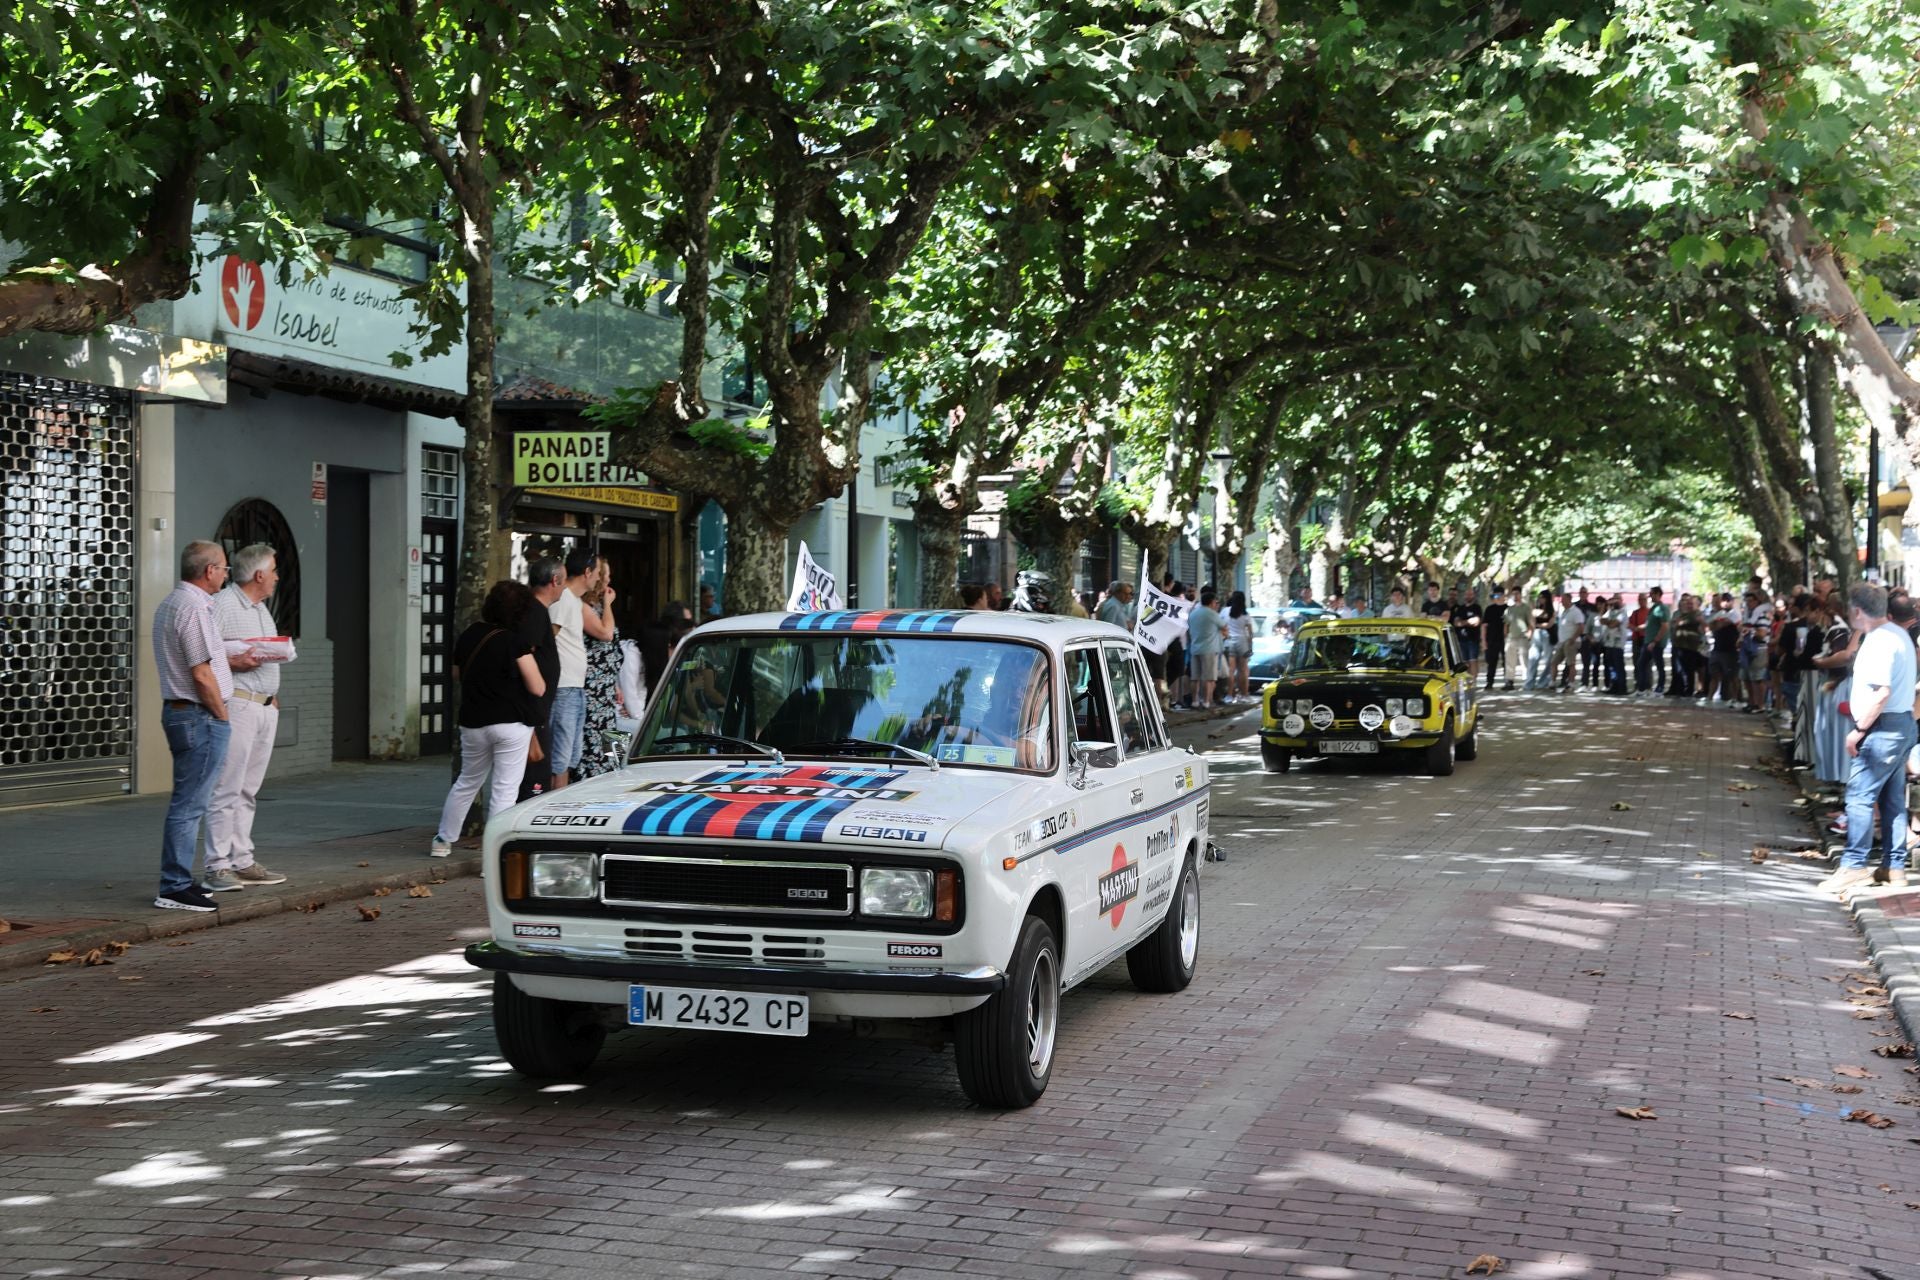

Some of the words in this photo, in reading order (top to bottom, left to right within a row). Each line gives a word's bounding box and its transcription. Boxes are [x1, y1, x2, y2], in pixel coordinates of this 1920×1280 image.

[274, 265, 323, 295] Cntro
[331, 281, 346, 301] de
[353, 287, 404, 315] estudios
[274, 301, 338, 347] Isabel
[518, 437, 605, 458] PANADE
[943, 749, 960, 760] 25
[1319, 741, 1328, 752] M
[1337, 741, 1362, 751] 1224
[648, 782, 898, 799] MARTINI
[530, 815, 611, 827] SEAT
[839, 826, 927, 843] SEAT
[1014, 829, 1032, 850] TEAM
[1032, 816, 1058, 842] EAT
[787, 888, 828, 899] SEAT
[1100, 866, 1138, 909] MARTINI
[514, 925, 561, 937] FERODO
[889, 944, 940, 956] FERODO
[646, 991, 663, 1021] M
[676, 993, 749, 1027] 2432
[765, 1000, 804, 1030] CP
